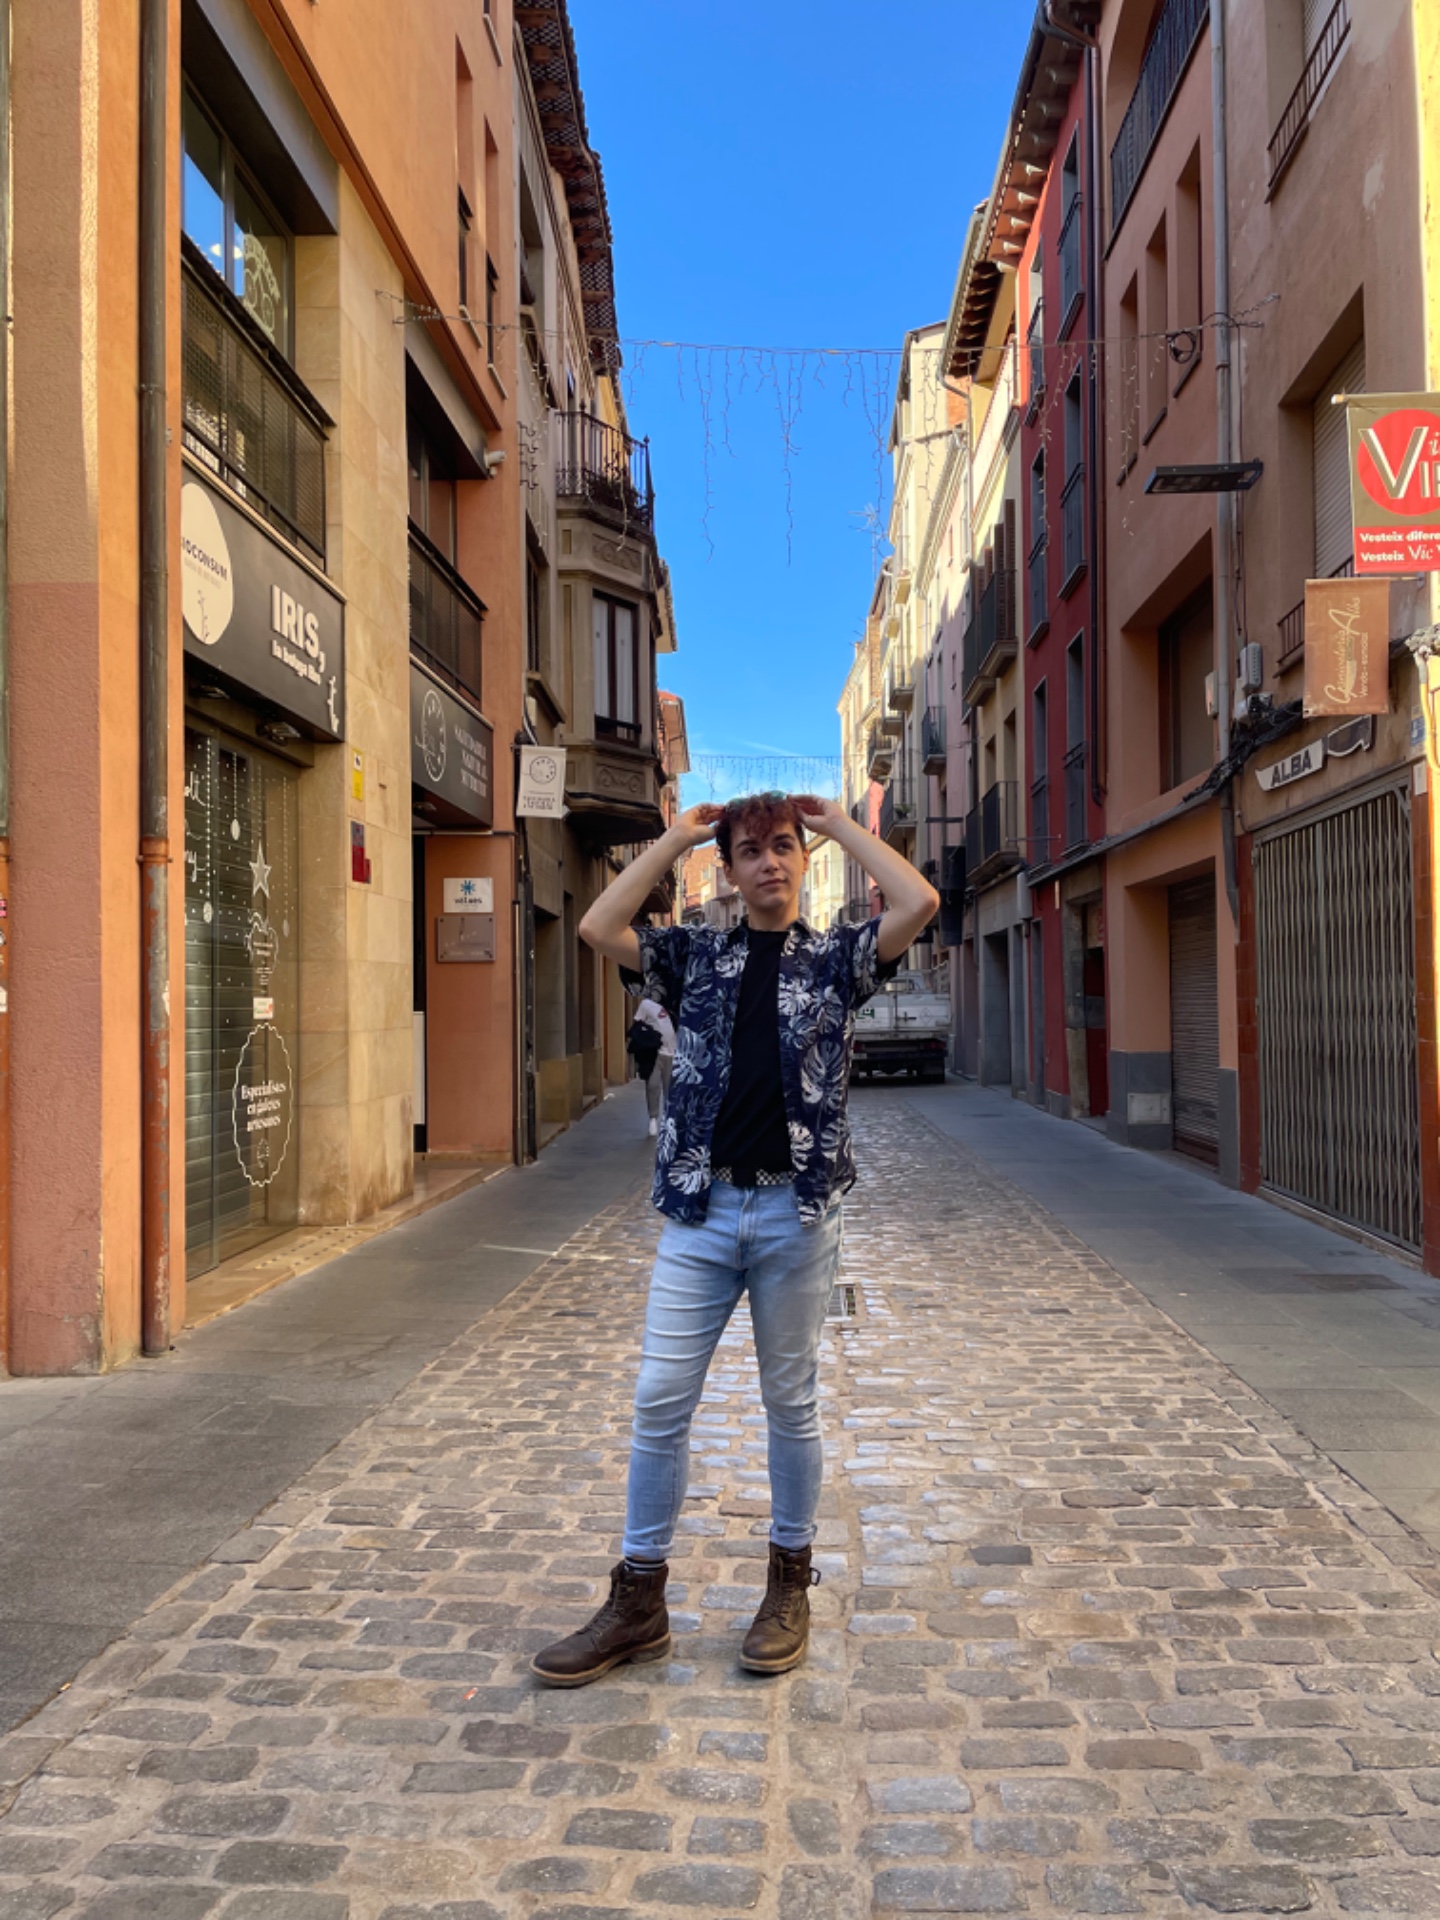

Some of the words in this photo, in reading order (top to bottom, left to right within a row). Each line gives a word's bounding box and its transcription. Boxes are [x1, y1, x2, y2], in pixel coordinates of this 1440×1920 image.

[1359, 531, 1404, 543] Vesteix
[1360, 550, 1404, 562] Vesteix
[1408, 544, 1433, 560] Vic
[1328, 597, 1361, 635] Alba
[1359, 671, 1369, 698] Venda
[1271, 749, 1312, 787] ALBA
